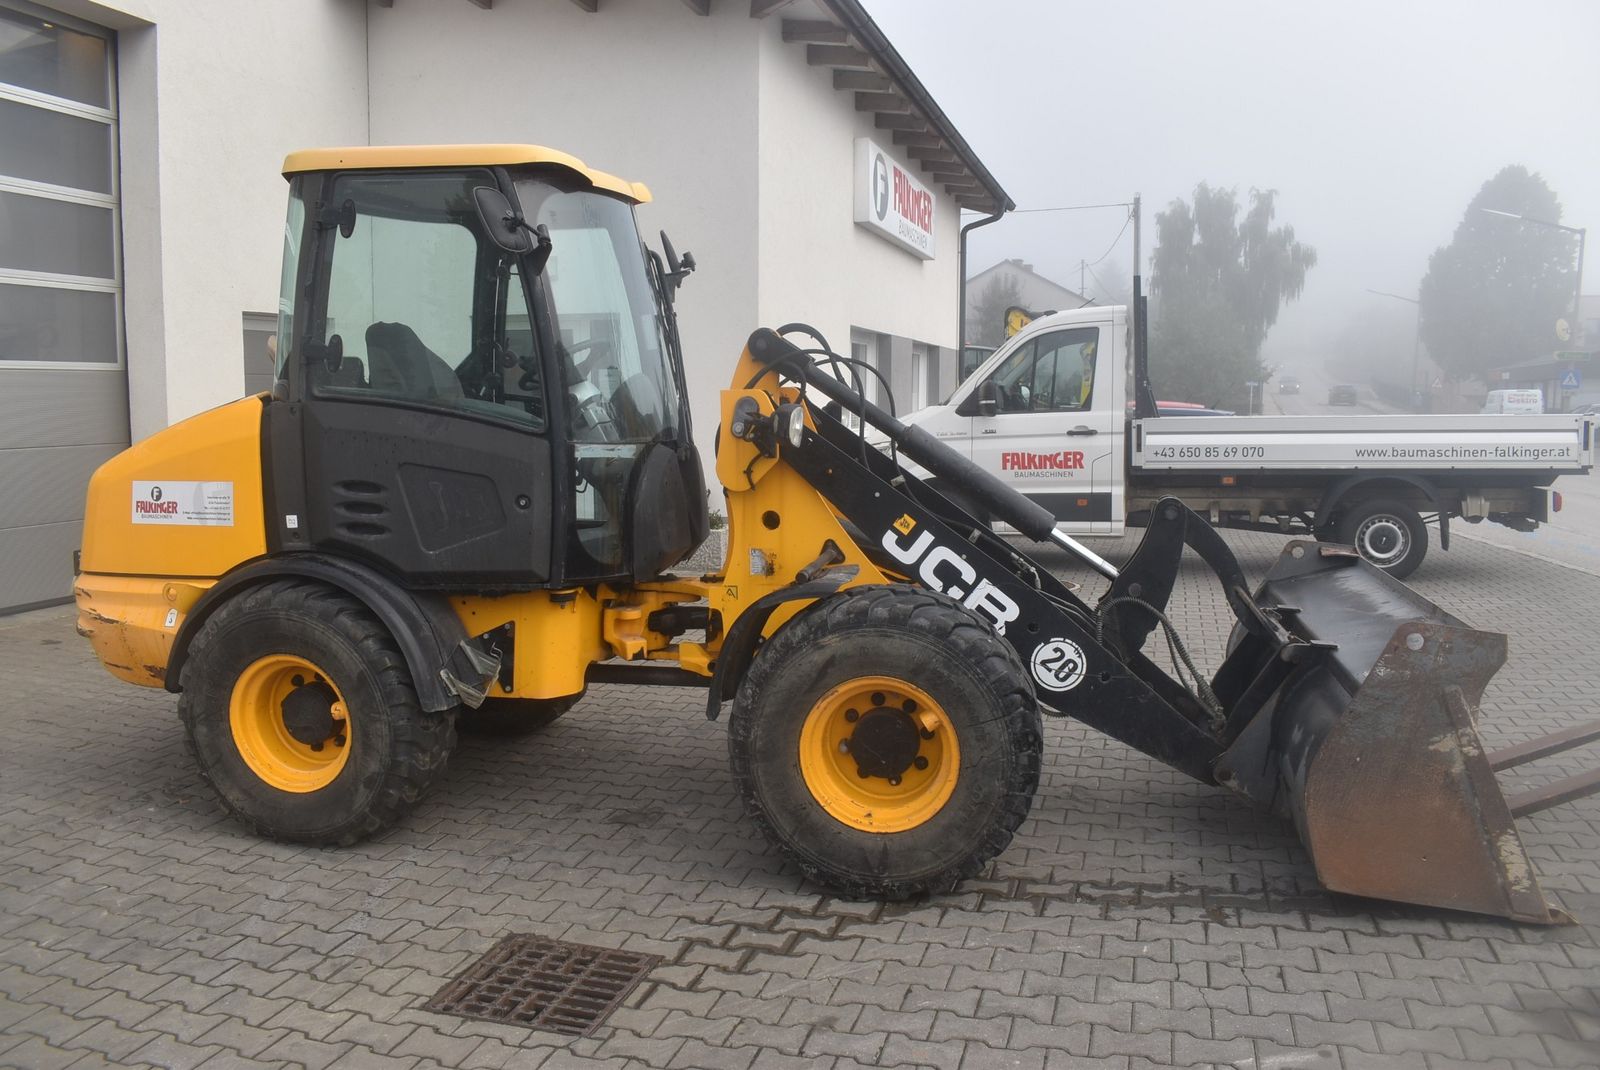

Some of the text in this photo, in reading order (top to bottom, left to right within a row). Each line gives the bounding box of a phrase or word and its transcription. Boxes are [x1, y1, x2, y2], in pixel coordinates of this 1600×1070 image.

[893, 165, 932, 236] FALKINGER
[1153, 446, 1265, 458] +43 650 85 69 070
[1355, 446, 1571, 460] www.baumaschinen-falkinger.at
[1001, 451, 1085, 470] FALKINGER
[135, 500, 178, 514] FALKINGER
[881, 529, 1020, 637] JCB
